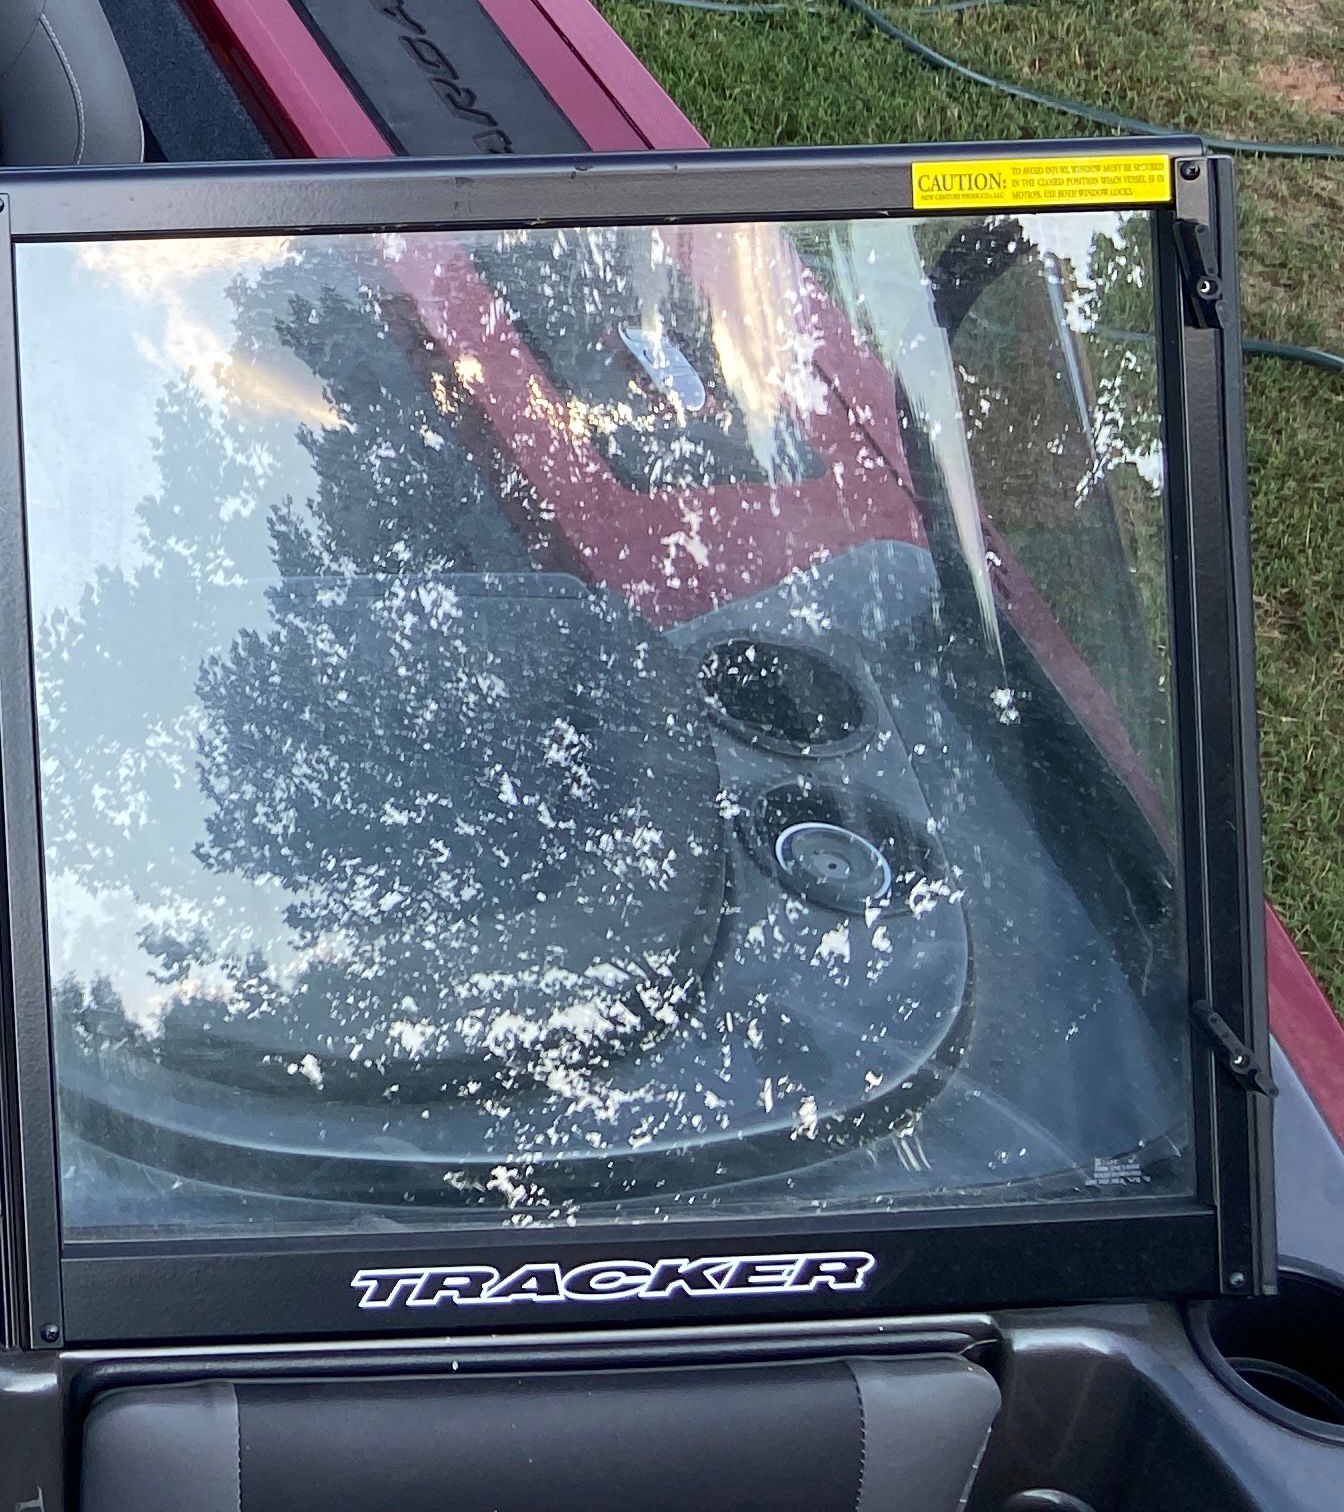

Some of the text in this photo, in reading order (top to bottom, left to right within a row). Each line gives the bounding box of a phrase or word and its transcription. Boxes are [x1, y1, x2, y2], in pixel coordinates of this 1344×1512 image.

[918, 172, 1007, 192] CAUTION:
[1022, 178, 1035, 187] THE
[1058, 189, 1076, 198] BOTH
[1078, 188, 1108, 197] WINDOW
[351, 1251, 876, 1309] TRACKER
